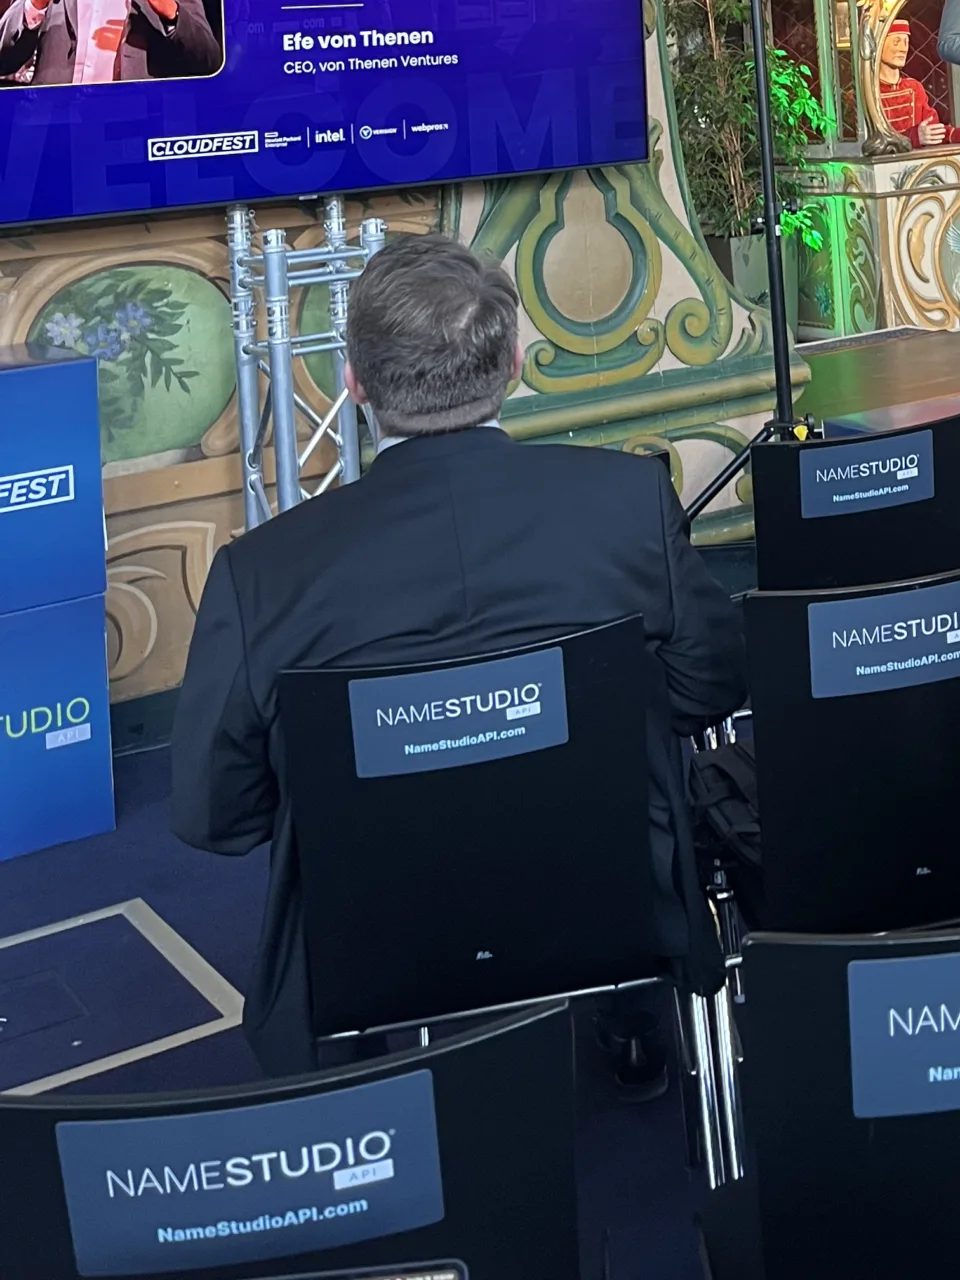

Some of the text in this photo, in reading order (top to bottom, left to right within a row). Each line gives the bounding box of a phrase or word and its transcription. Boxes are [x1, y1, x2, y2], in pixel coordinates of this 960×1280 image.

[283, 30, 434, 51] Efe von Thenen
[283, 54, 459, 74] CEO, von Thenen Ventures
[152, 135, 254, 156] CLOUDFEST
[832, 484, 909, 502] NameStudioAPI.com
[404, 726, 526, 755] NameStudioAPI.com
[156, 1197, 369, 1243] NameStudioAPI.com
